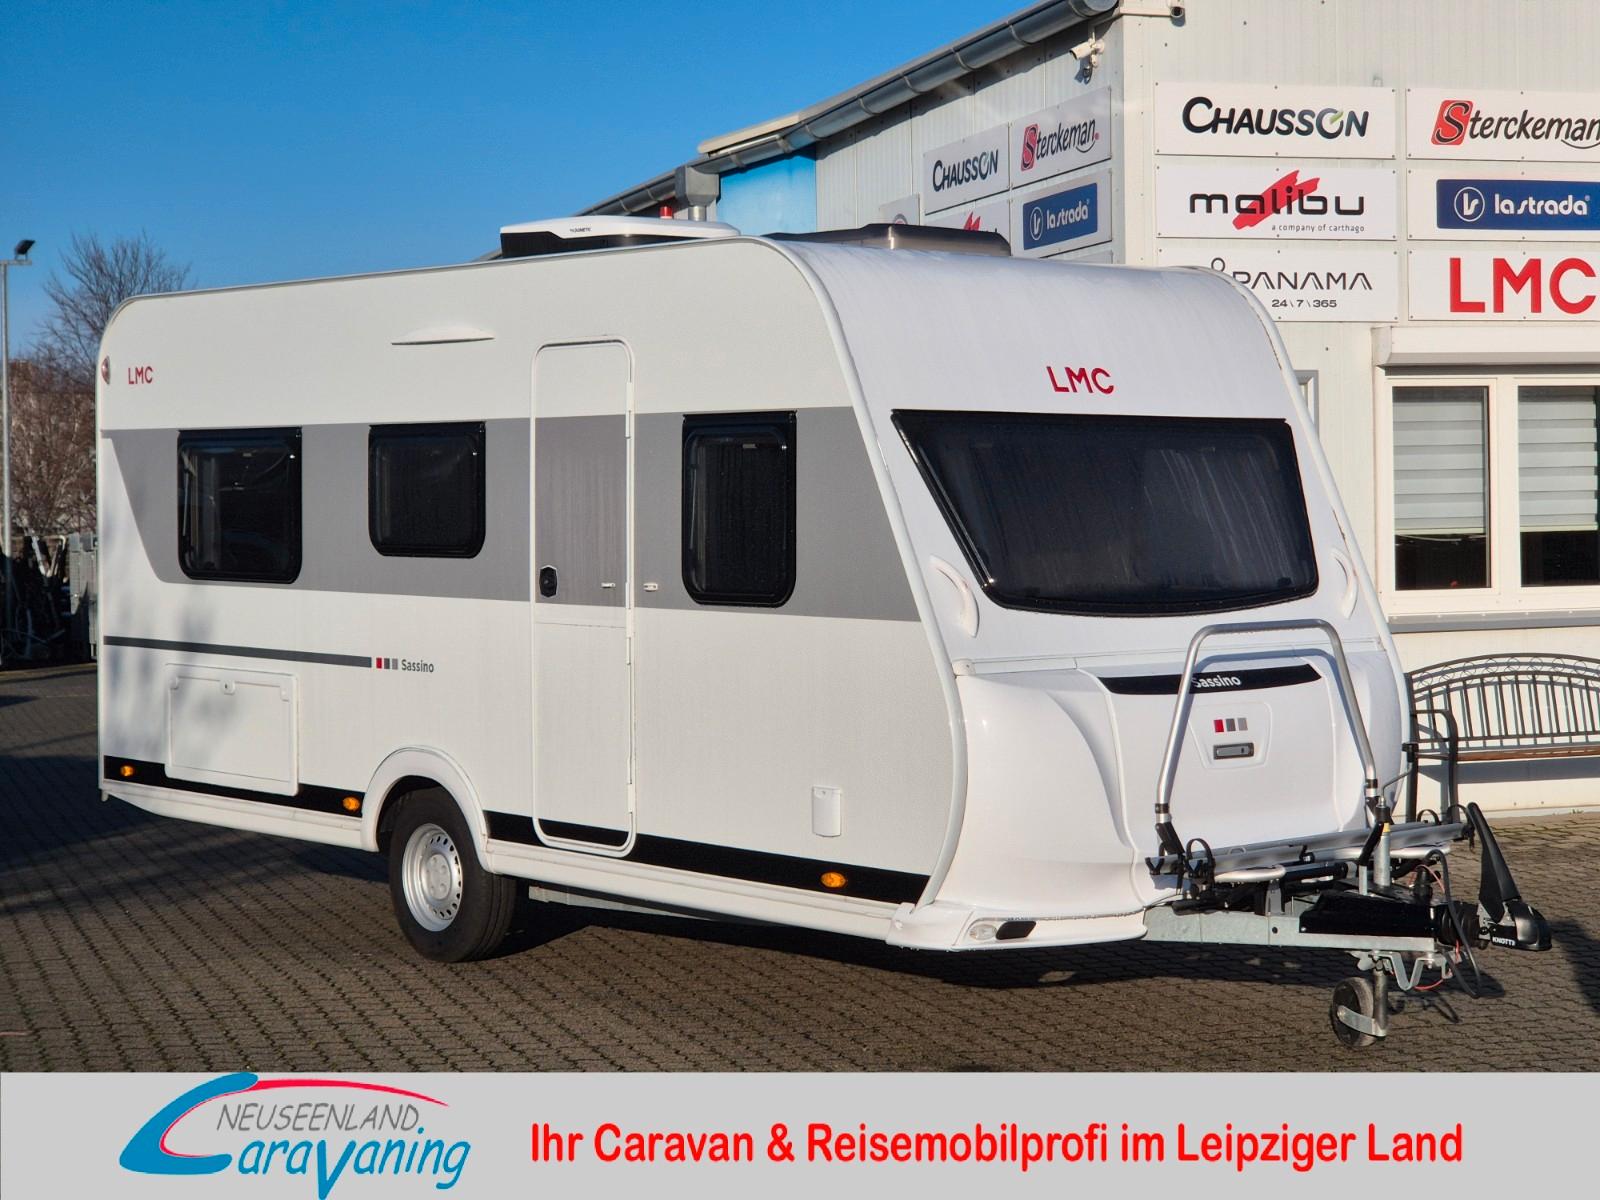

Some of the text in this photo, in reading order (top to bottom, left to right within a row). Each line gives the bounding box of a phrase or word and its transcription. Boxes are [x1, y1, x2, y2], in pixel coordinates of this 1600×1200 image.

[1182, 96, 1369, 139] CHAUSSON
[1434, 100, 1600, 143] Sterckeman
[1021, 119, 1096, 170] Sterckeman
[932, 149, 999, 192] CHAUSSON
[1189, 185, 1365, 216] malibu
[1278, 225, 1315, 233] company
[1317, 224, 1327, 232] of
[1328, 224, 1365, 233] carthago
[1232, 271, 1373, 291] PANAMA
[1450, 257, 1596, 315] LMC
[127, 366, 154, 385] LMC
[1046, 366, 1115, 395] LMC
[401, 658, 435, 673] Sassino
[1191, 674, 1242, 688] Sassino
